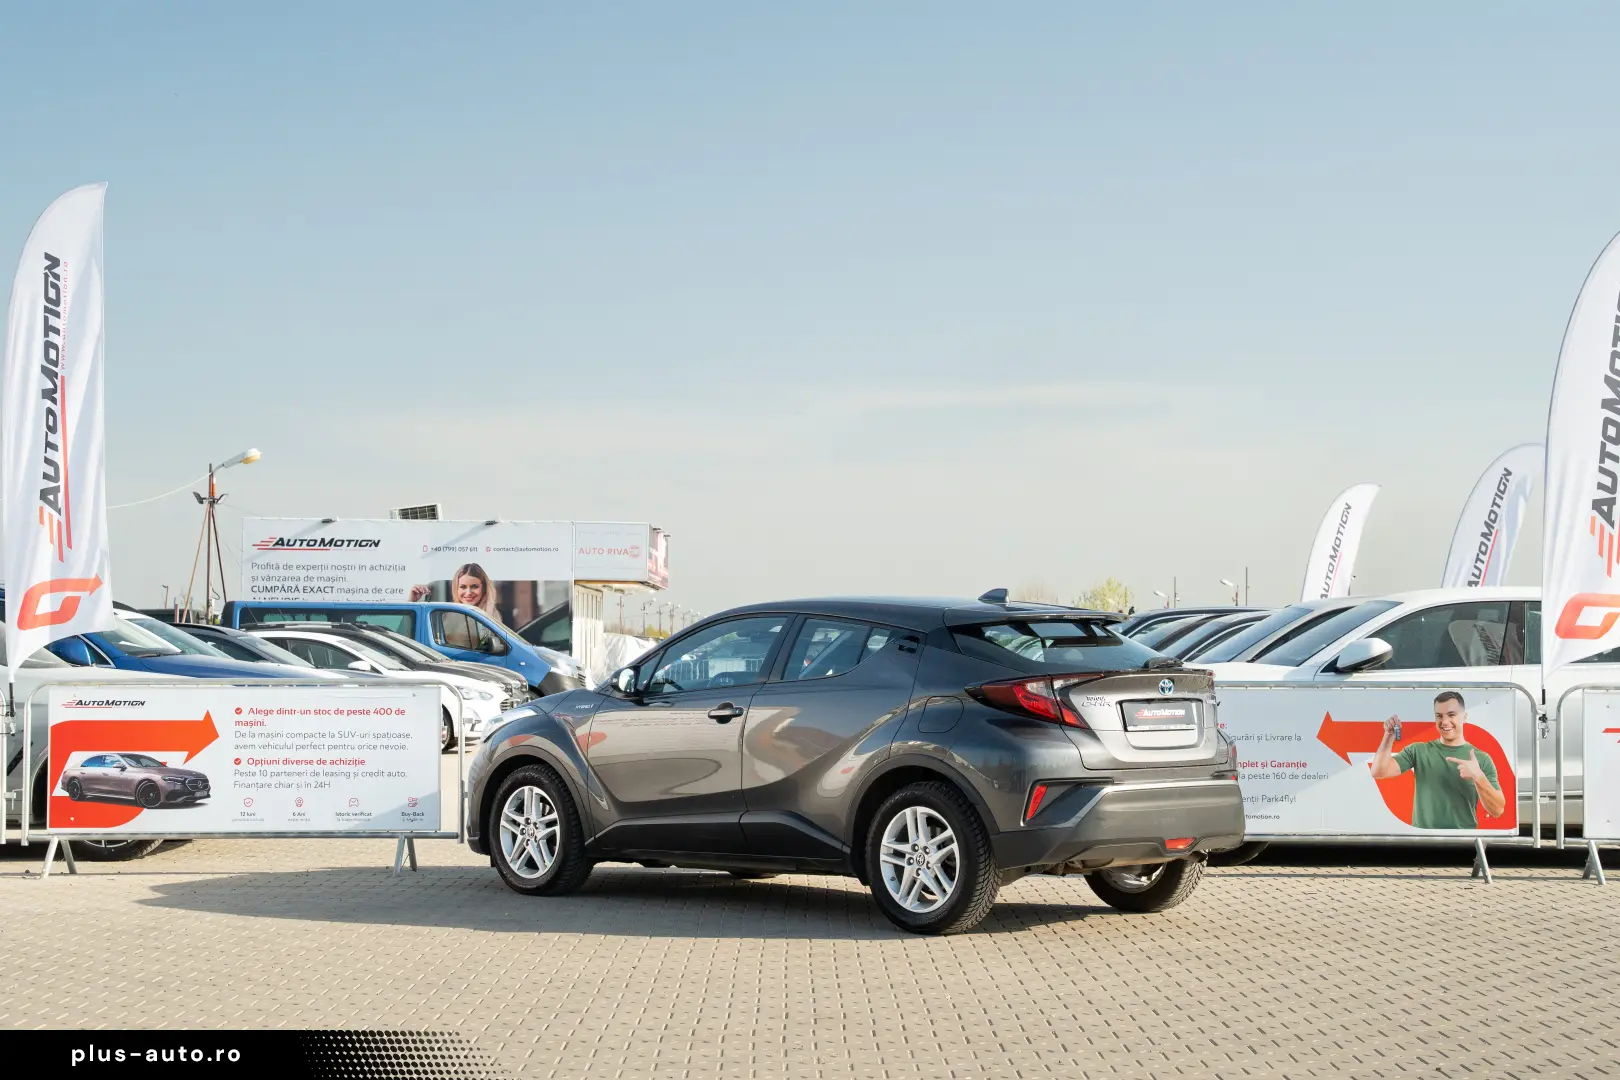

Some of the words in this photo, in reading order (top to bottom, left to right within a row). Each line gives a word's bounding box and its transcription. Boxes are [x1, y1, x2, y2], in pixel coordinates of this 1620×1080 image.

[578, 547, 605, 555] AUTO
[251, 562, 280, 571] Profită
[283, 562, 293, 571] de
[296, 563, 329, 573] experții
[331, 563, 356, 573] noștri
[369, 562, 406, 573] achiziția
[251, 574, 259, 583] și
[303, 574, 315, 582] de
[317, 575, 348, 584] mașini.
[251, 585, 301, 594] CUMPĂRĂ
[302, 586, 334, 594] EXACT
[337, 586, 369, 596] mașina
[371, 586, 383, 594] de
[248, 707, 275, 716] Alege
[276, 707, 311, 716] dintr-un
[313, 708, 332, 716] stoc
[334, 707, 345, 716] de
[346, 708, 371, 717] peste
[373, 708, 393, 716] 400
[394, 707, 406, 716] de
[234, 719, 267, 728] mașini.
[234, 731, 248, 739] De
[249, 730, 256, 739] la
[258, 730, 284, 740] mașini
[286, 732, 327, 741] compacte
[328, 730, 336, 739] la
[337, 731, 371, 739] SUV-uri
[372, 731, 413, 741] spațioase,
[1256, 733, 1264, 744] și
[1265, 733, 1293, 741] Livrare
[1294, 733, 1302, 741] la
[258, 742, 294, 750] vehiculul
[295, 742, 326, 751] perfect
[328, 743, 355, 751] pentru
[247, 757, 280, 767] Opțiuni
[282, 757, 314, 766] diverse
[316, 757, 327, 766] de
[329, 757, 366, 767] achiziție
[1260, 760, 1268, 769] și
[1270, 760, 1308, 769] Garanție
[234, 769, 257, 777] Peste
[259, 769, 268, 777] 10
[270, 770, 308, 778] parteneri
[309, 769, 321, 777] de
[322, 769, 351, 779] leasing
[353, 769, 360, 779] și
[361, 769, 385, 778] credit
[1247, 772, 1271, 781] peste
[1272, 772, 1287, 780] 160
[1288, 772, 1300, 780] de
[1301, 771, 1329, 780] dealeri
[233, 781, 272, 790] Finanțare
[274, 781, 294, 789] chiar
[296, 781, 302, 791] și
[304, 781, 312, 789] în
[313, 781, 331, 789] 24H
[1261, 794, 1297, 804] Park4fly!
